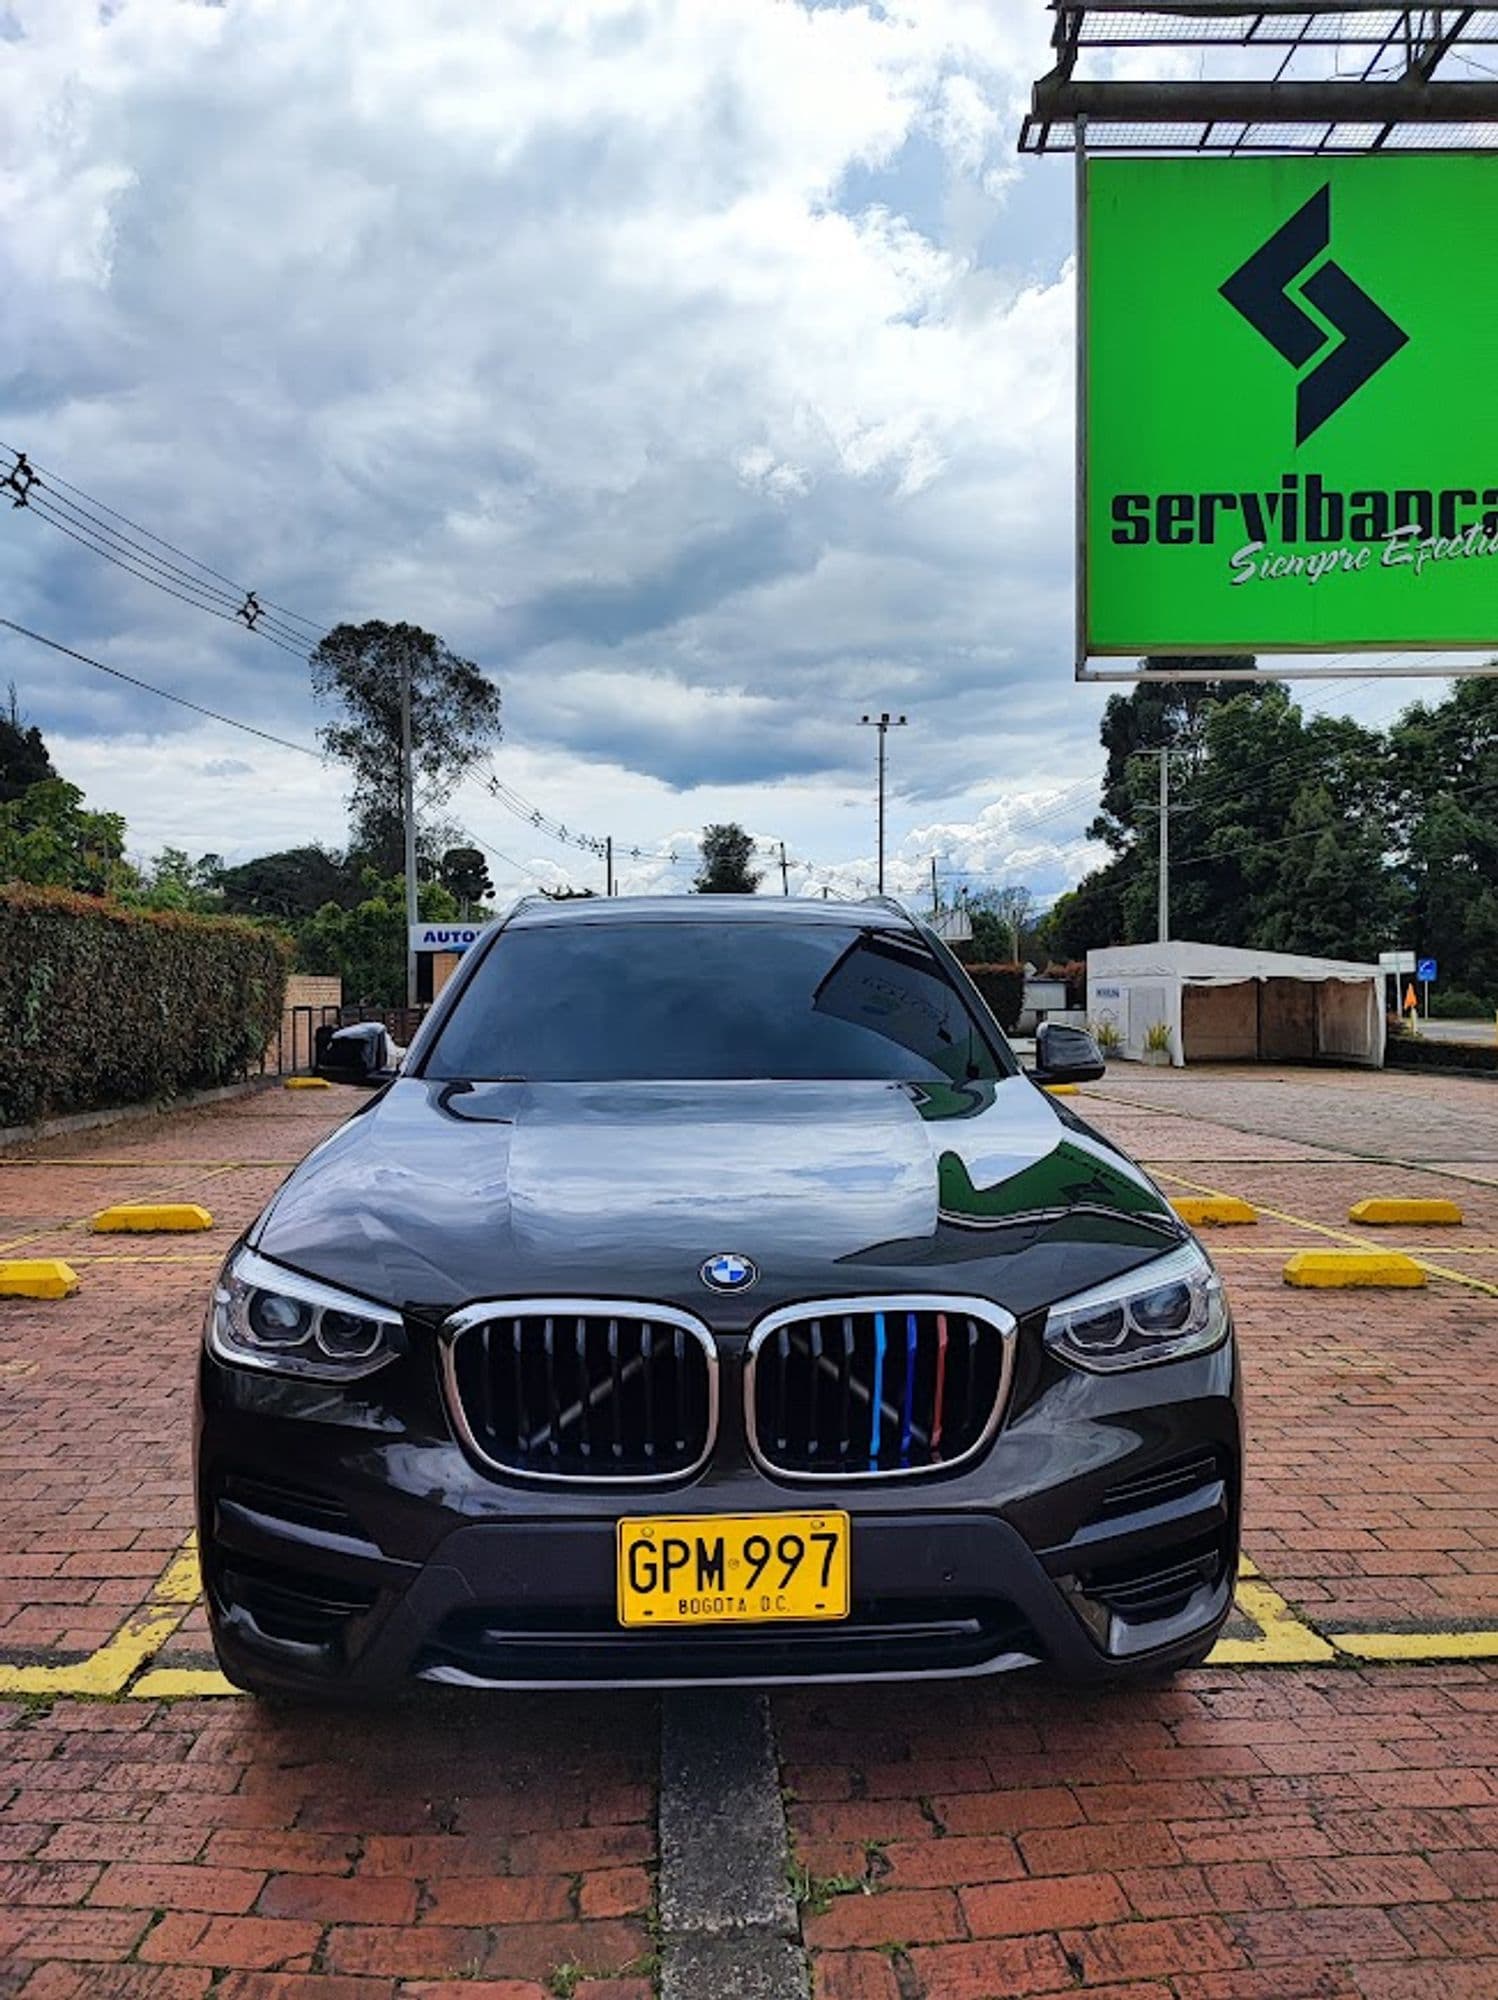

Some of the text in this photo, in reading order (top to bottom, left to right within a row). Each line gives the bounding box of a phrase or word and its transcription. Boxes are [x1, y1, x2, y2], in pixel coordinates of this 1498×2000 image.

[1229, 541, 1371, 585] Siempre
[423, 930, 480, 943] AUTO
[628, 1533, 838, 1593] GPM 997
[679, 1597, 747, 1614] BOGOTA
